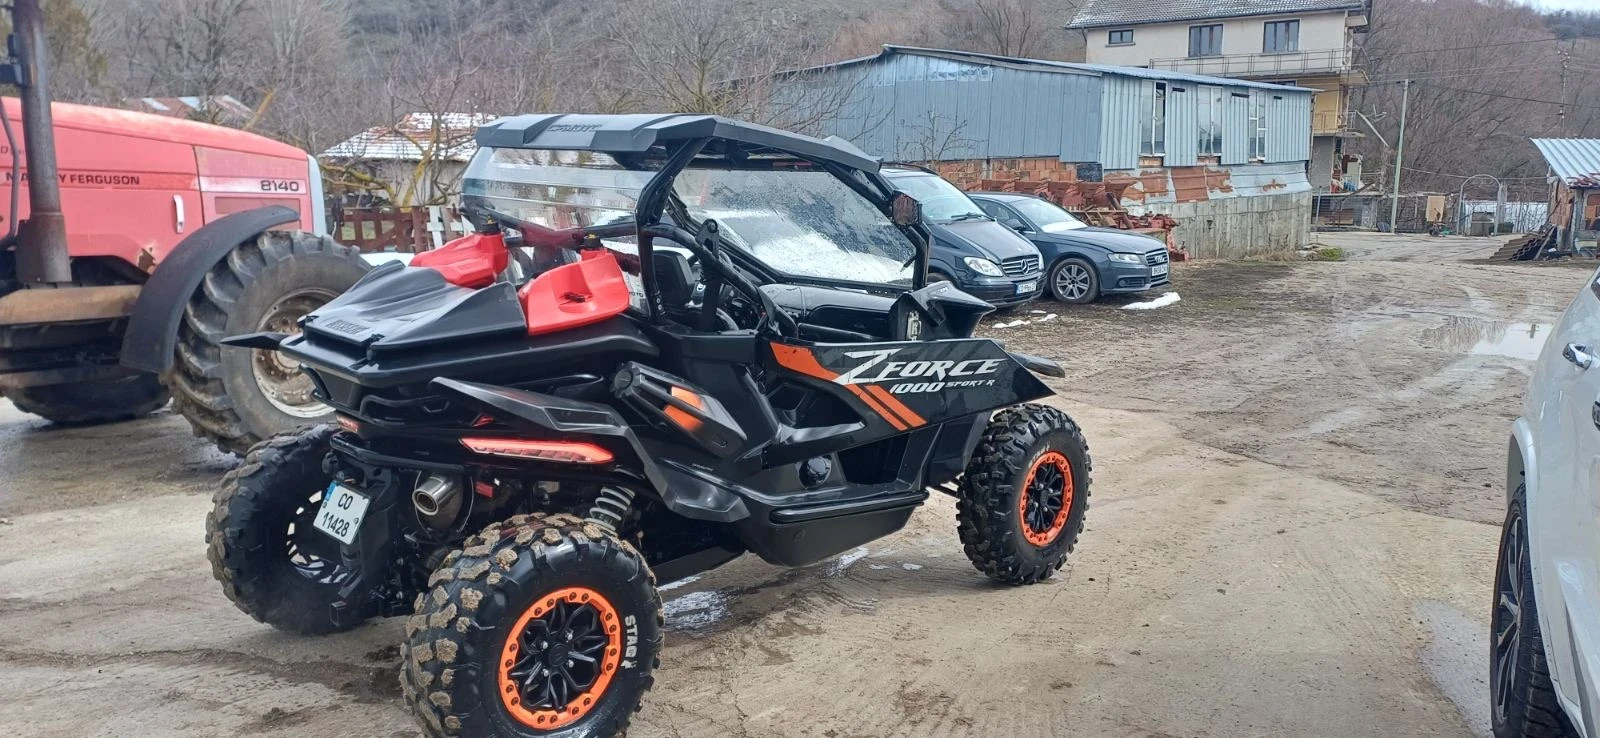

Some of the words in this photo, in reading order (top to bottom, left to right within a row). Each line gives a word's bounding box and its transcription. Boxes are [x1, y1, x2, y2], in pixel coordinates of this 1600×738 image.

[70, 174, 140, 185] FERGUSON
[260, 179, 300, 192] 8140
[889, 382, 946, 394] 1000
[945, 380, 985, 388] SPORT
[338, 493, 354, 510] CO
[322, 512, 350, 537] 11428
[625, 615, 639, 658] STAG
